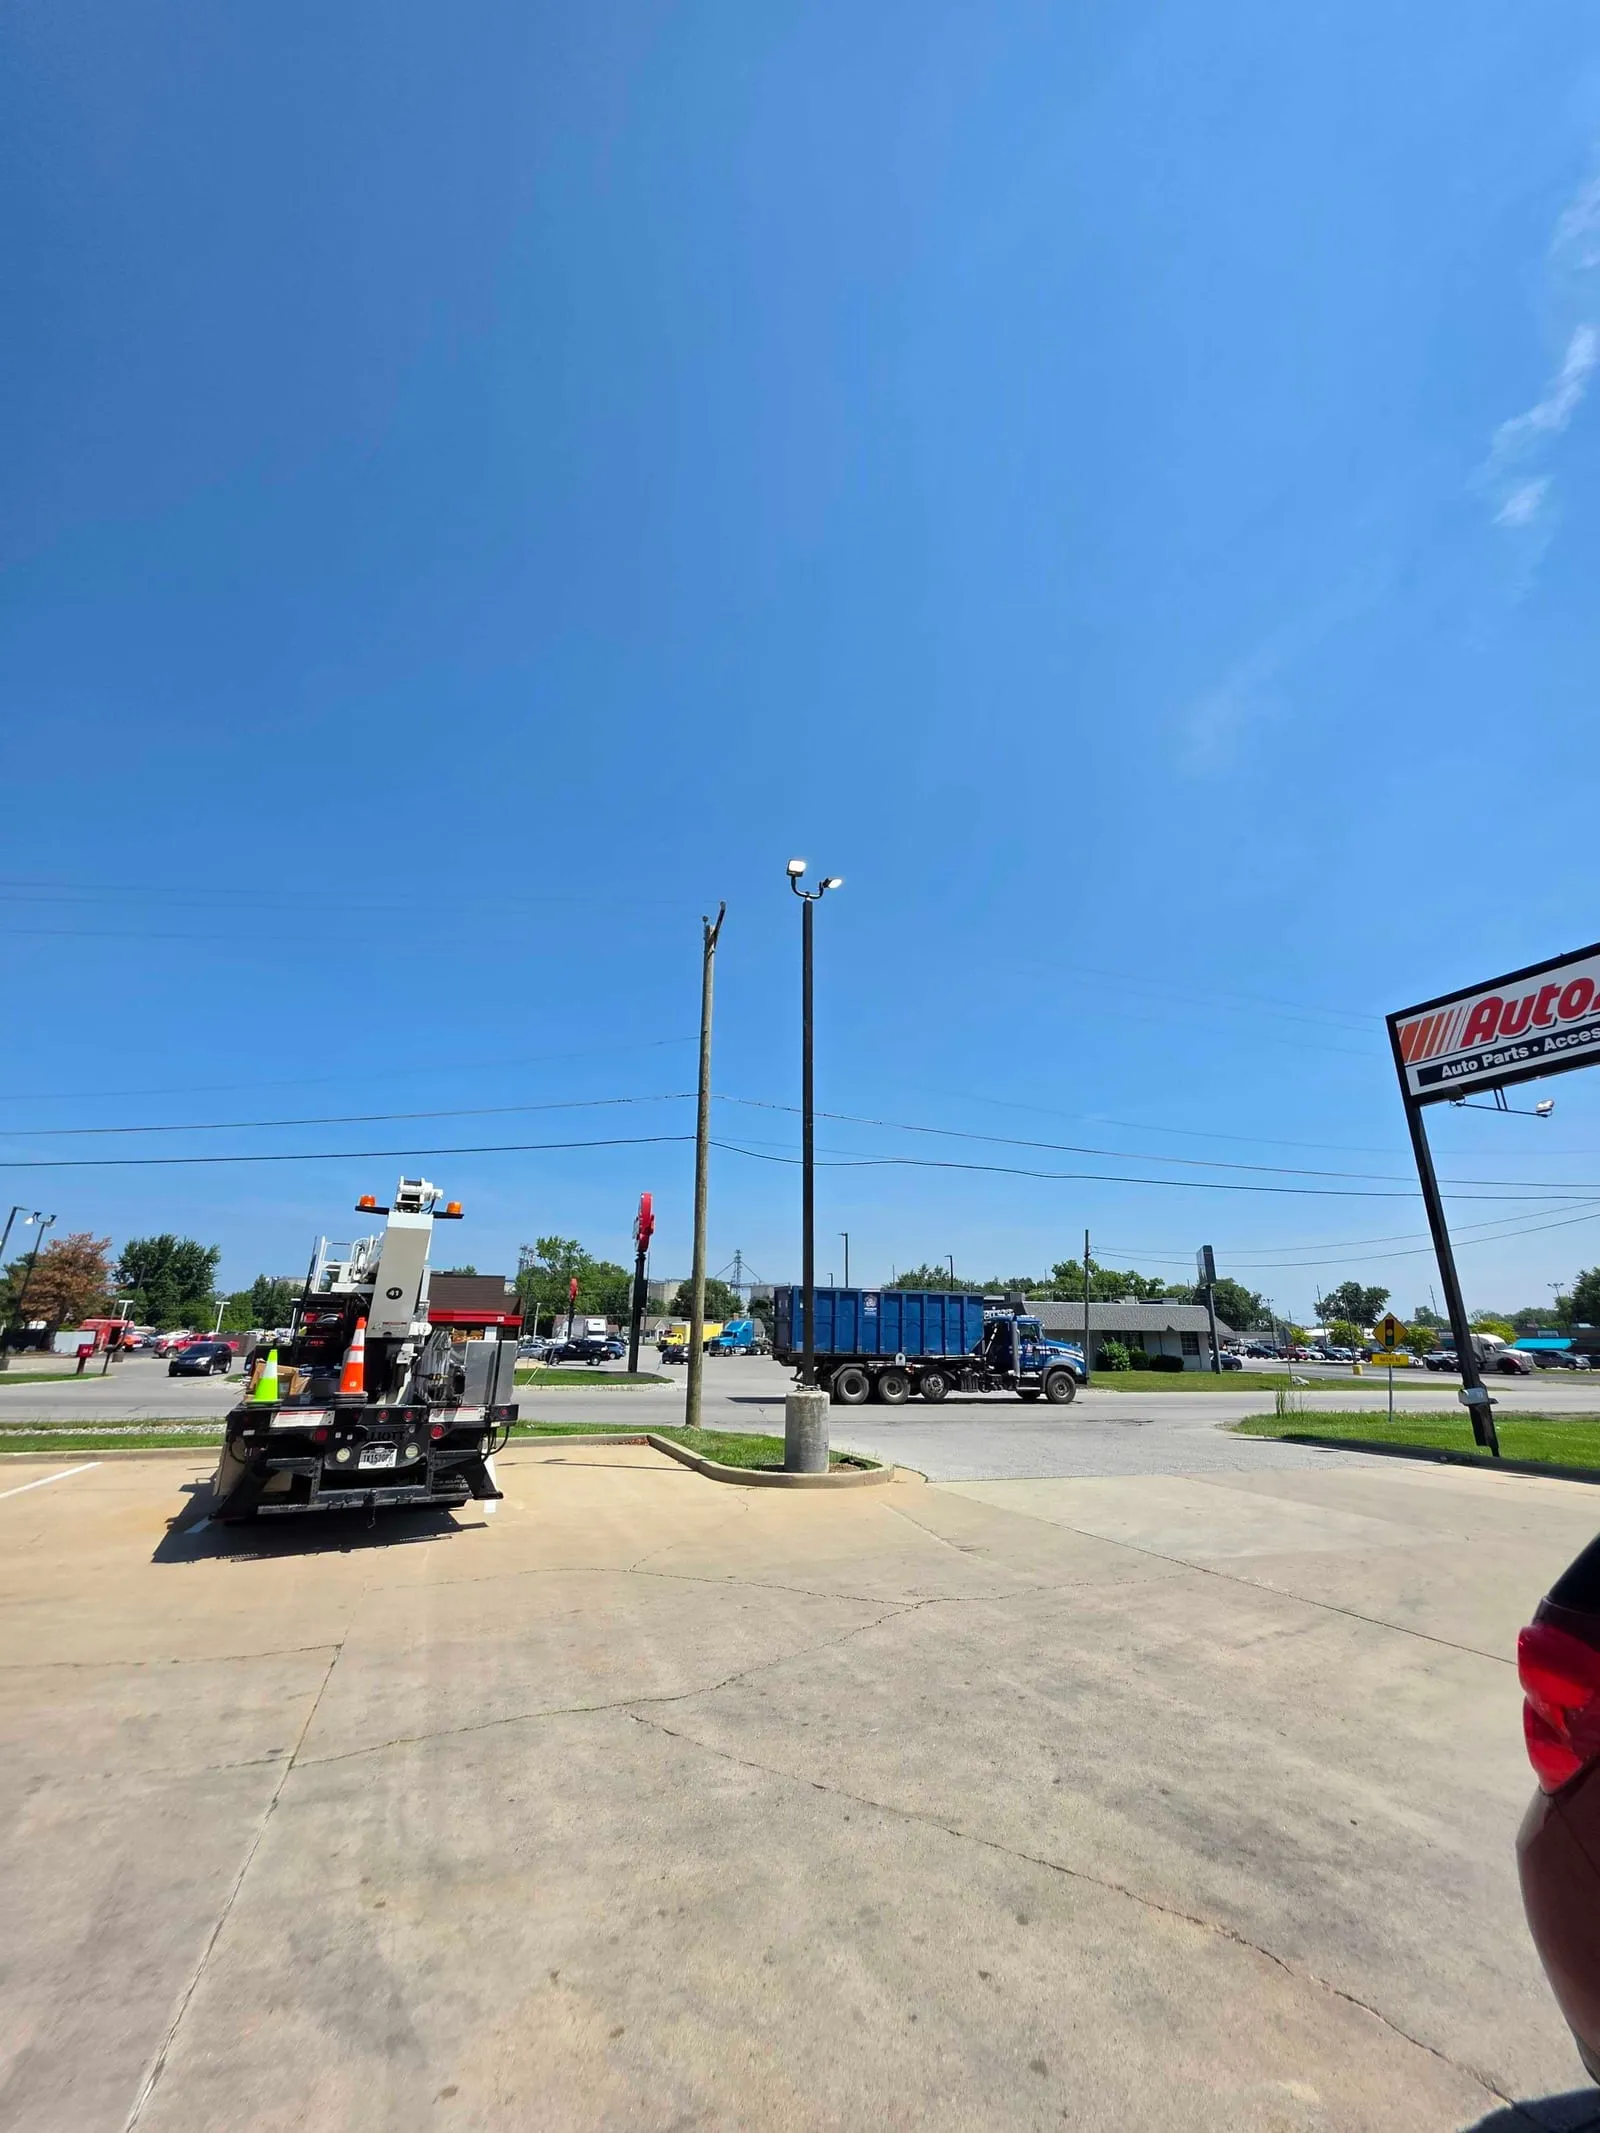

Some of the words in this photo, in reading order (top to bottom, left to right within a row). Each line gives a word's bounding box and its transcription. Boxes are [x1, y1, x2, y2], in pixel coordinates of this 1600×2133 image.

[1460, 977, 1600, 1049] Auto
[1442, 1059, 1478, 1079] Auto
[1482, 1047, 1529, 1067] Parts
